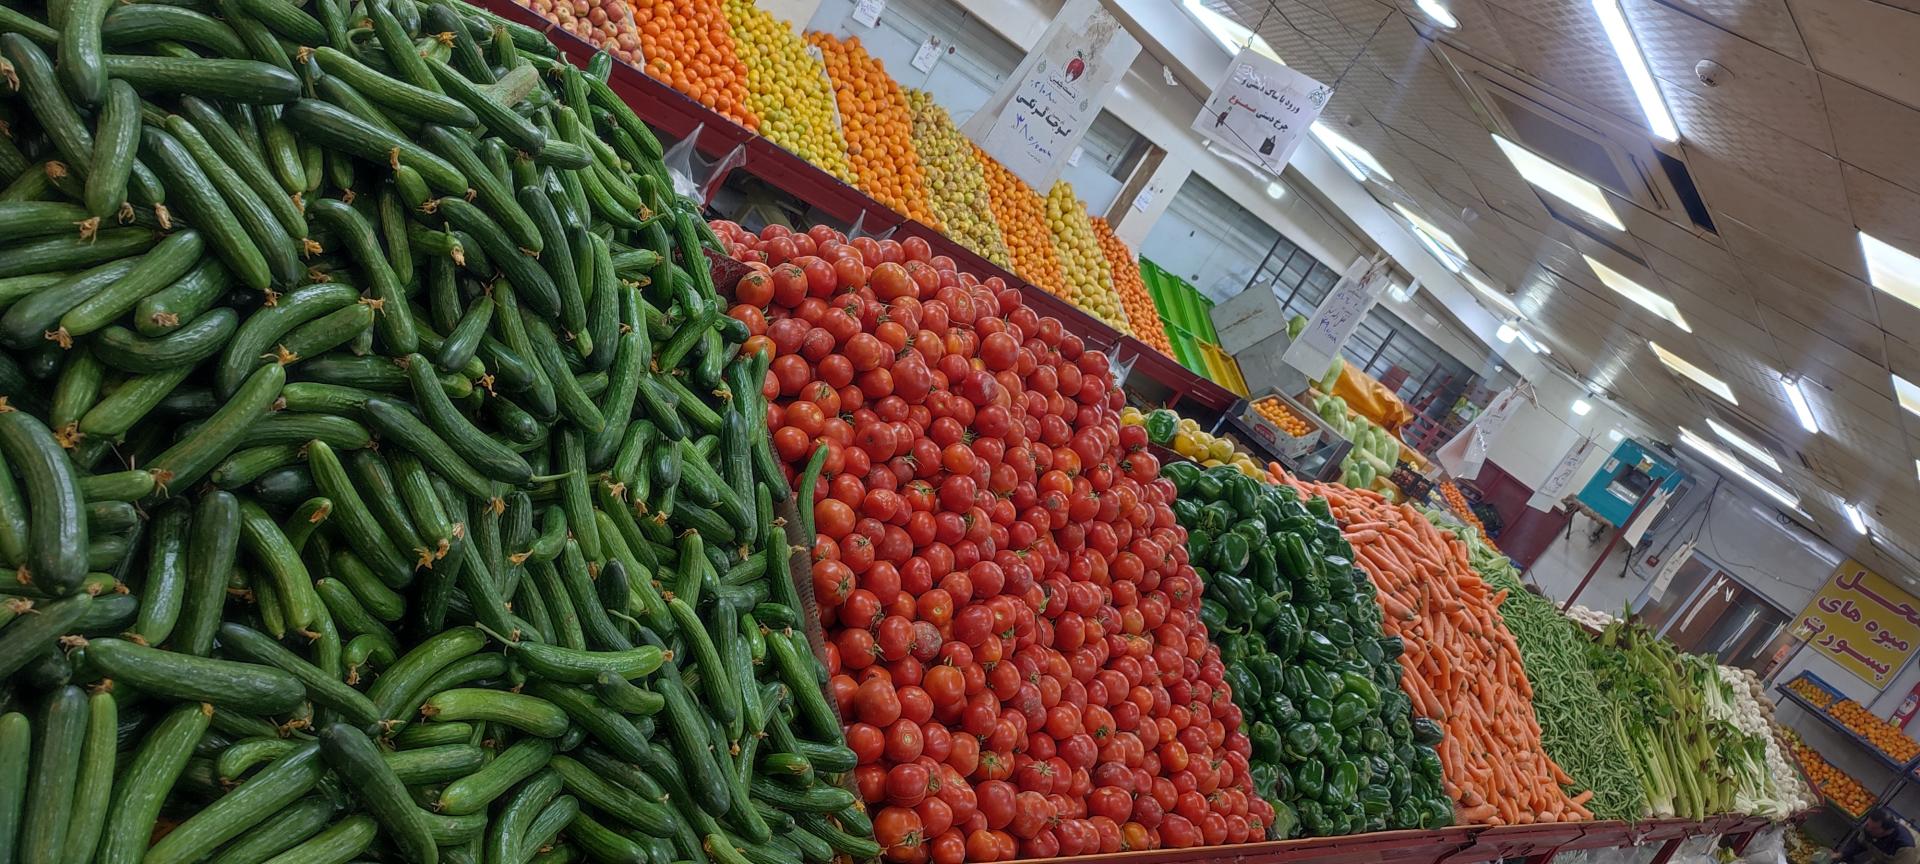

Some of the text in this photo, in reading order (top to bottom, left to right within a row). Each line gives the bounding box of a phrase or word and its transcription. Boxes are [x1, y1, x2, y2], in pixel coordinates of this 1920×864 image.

[1228, 95, 1256, 113] ممنوع
[1279, 95, 1285, 105] با
[1285, 100, 1300, 114] ورود
[1255, 111, 1274, 123] دستی
[1818, 597, 1909, 651] میوه های
